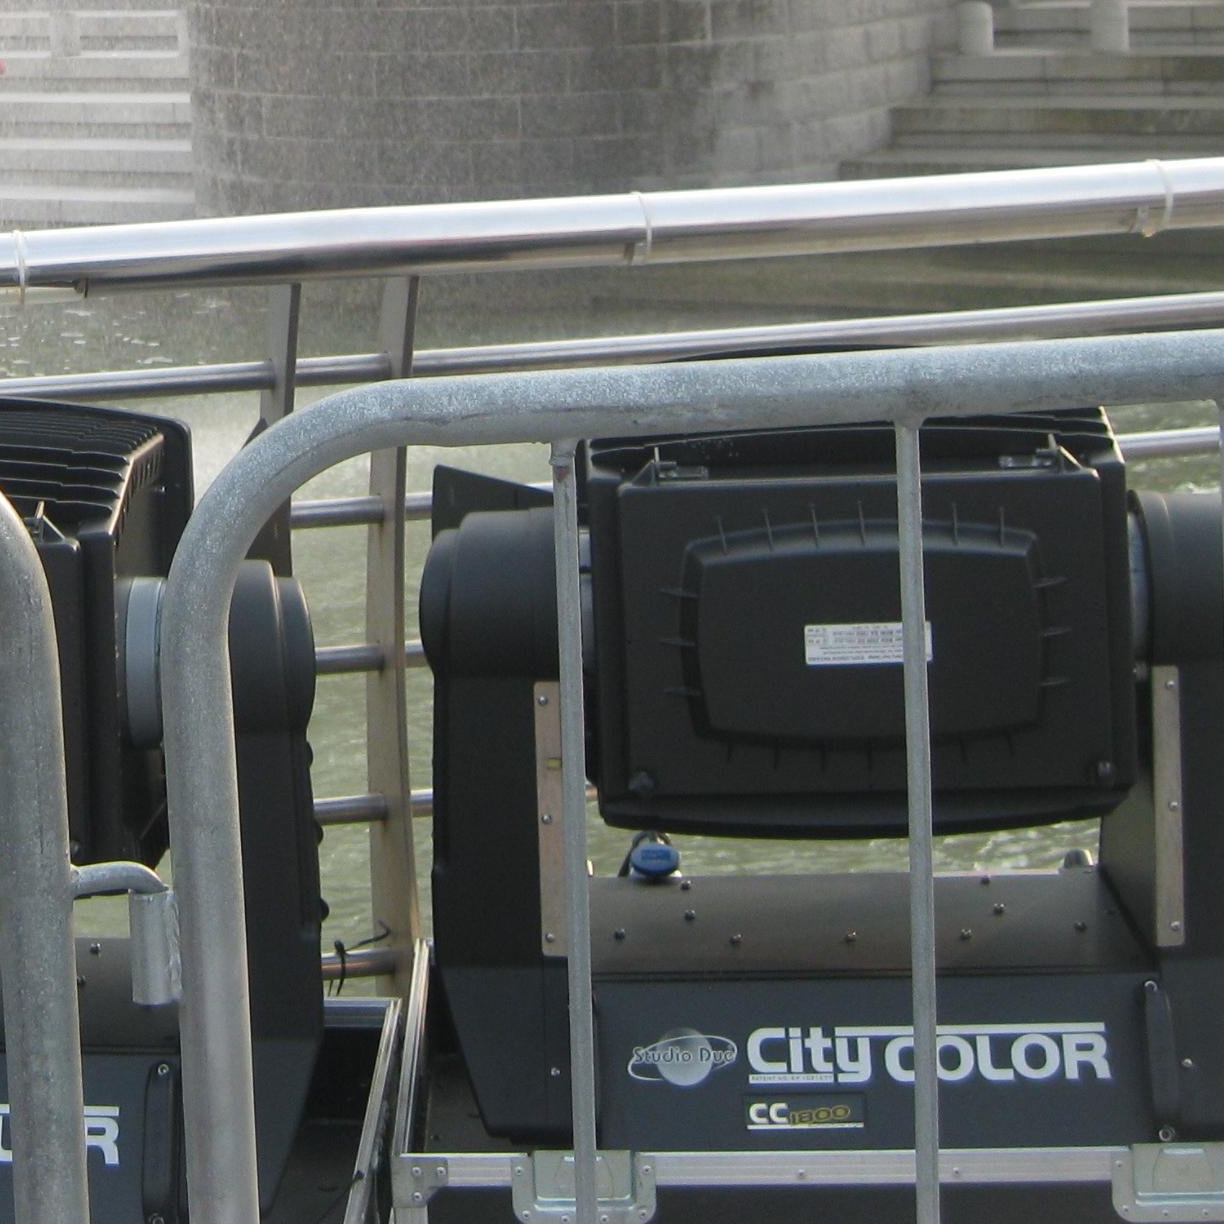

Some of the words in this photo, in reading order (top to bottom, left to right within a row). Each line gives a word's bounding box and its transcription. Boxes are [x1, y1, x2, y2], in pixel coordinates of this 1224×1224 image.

[633, 1046, 692, 1065] Studio
[747, 1026, 872, 1084] City
[884, 1032, 1112, 1082] COLOR
